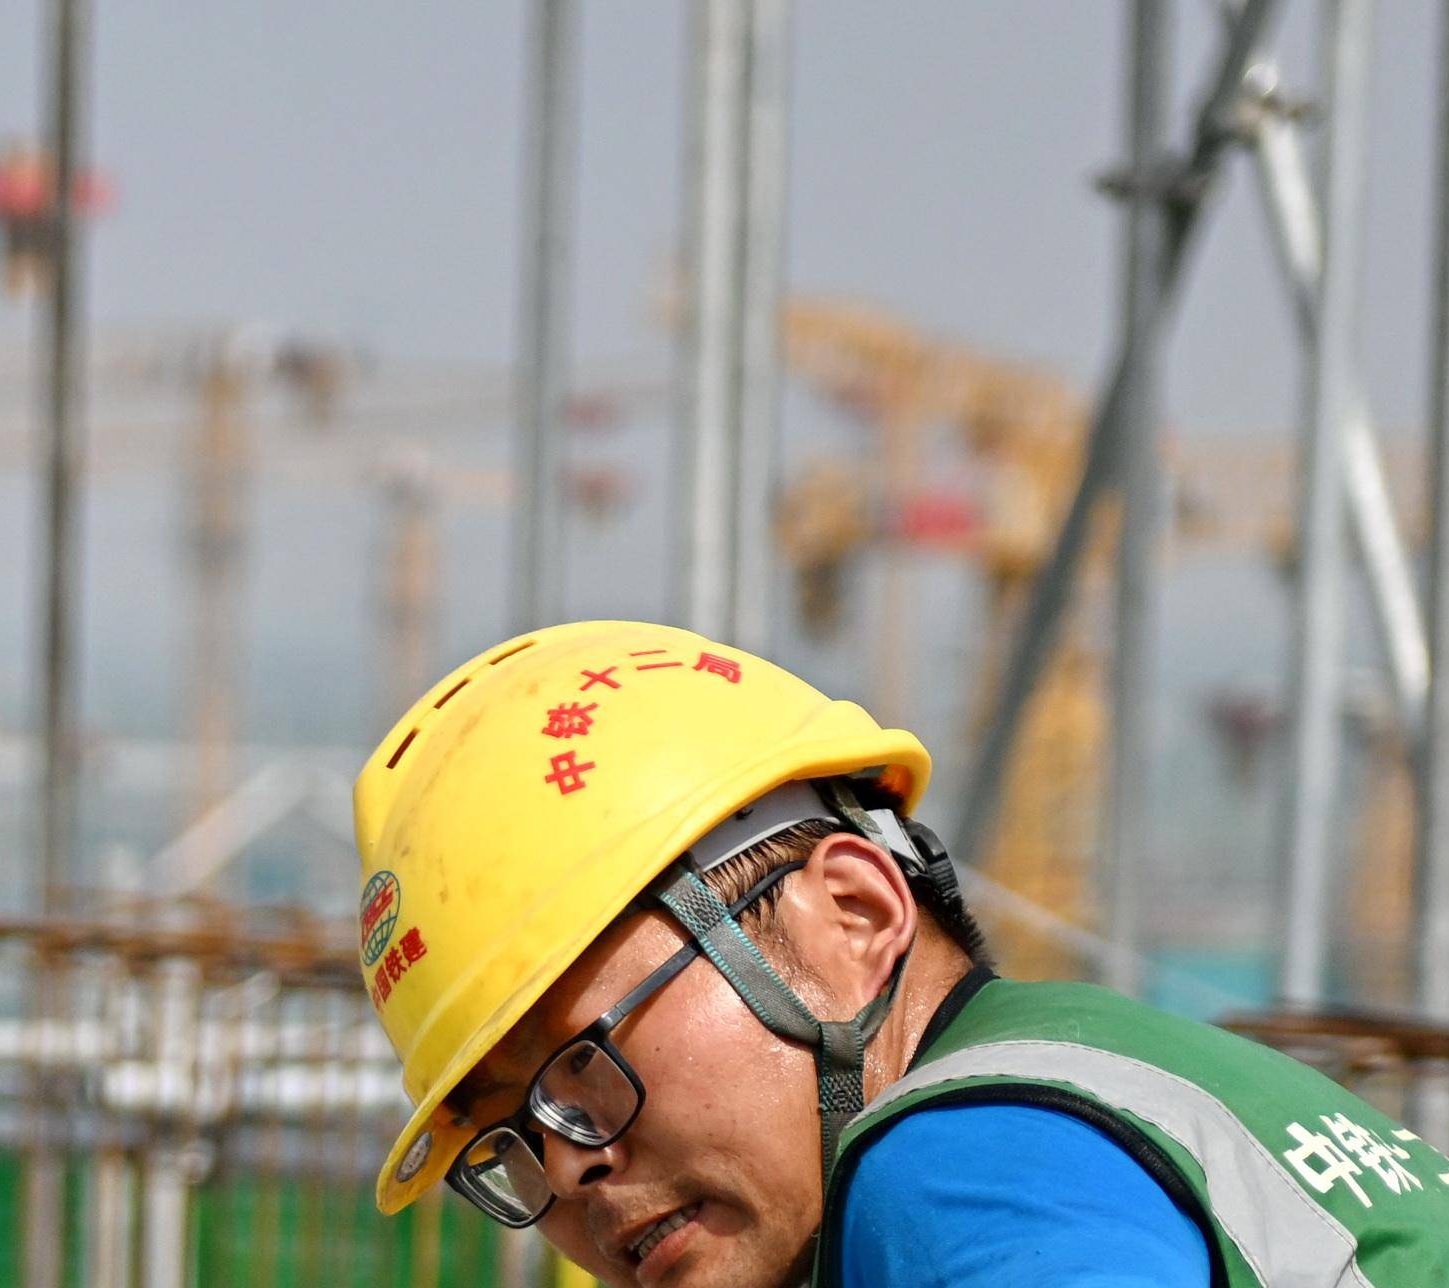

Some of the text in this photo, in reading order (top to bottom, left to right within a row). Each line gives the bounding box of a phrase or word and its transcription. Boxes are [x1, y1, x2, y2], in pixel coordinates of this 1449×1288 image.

[541, 649, 742, 795] 中铁十二局
